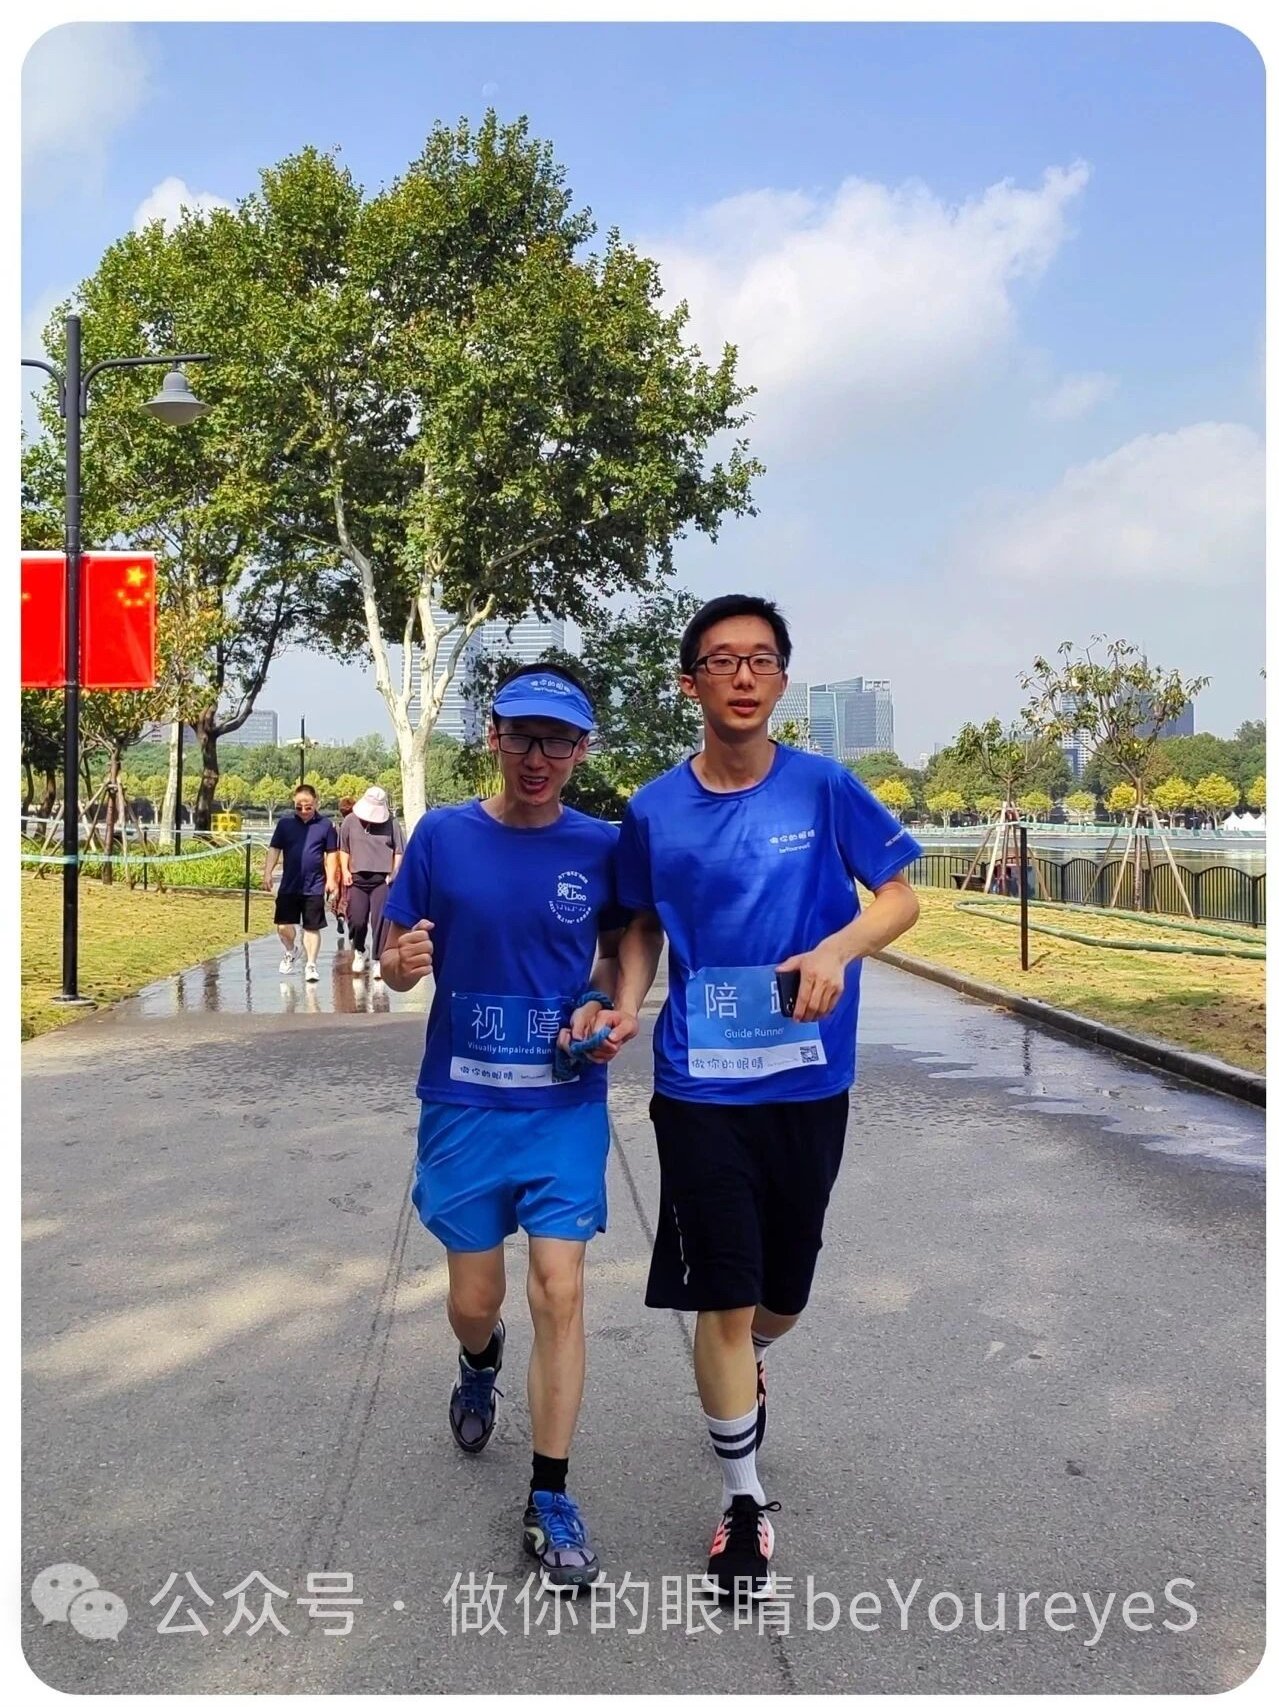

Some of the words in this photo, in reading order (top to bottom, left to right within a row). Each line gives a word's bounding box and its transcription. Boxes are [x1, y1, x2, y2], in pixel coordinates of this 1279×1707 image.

[471, 1002, 562, 1044] 视障
[724, 1028, 752, 1039] Guide
[754, 1026, 785, 1038] Runner
[467, 1041, 496, 1055] Visually
[498, 1045, 534, 1055] Impaired
[536, 1046, 553, 1055] Run
[691, 1055, 764, 1070] 做你的眼睛
